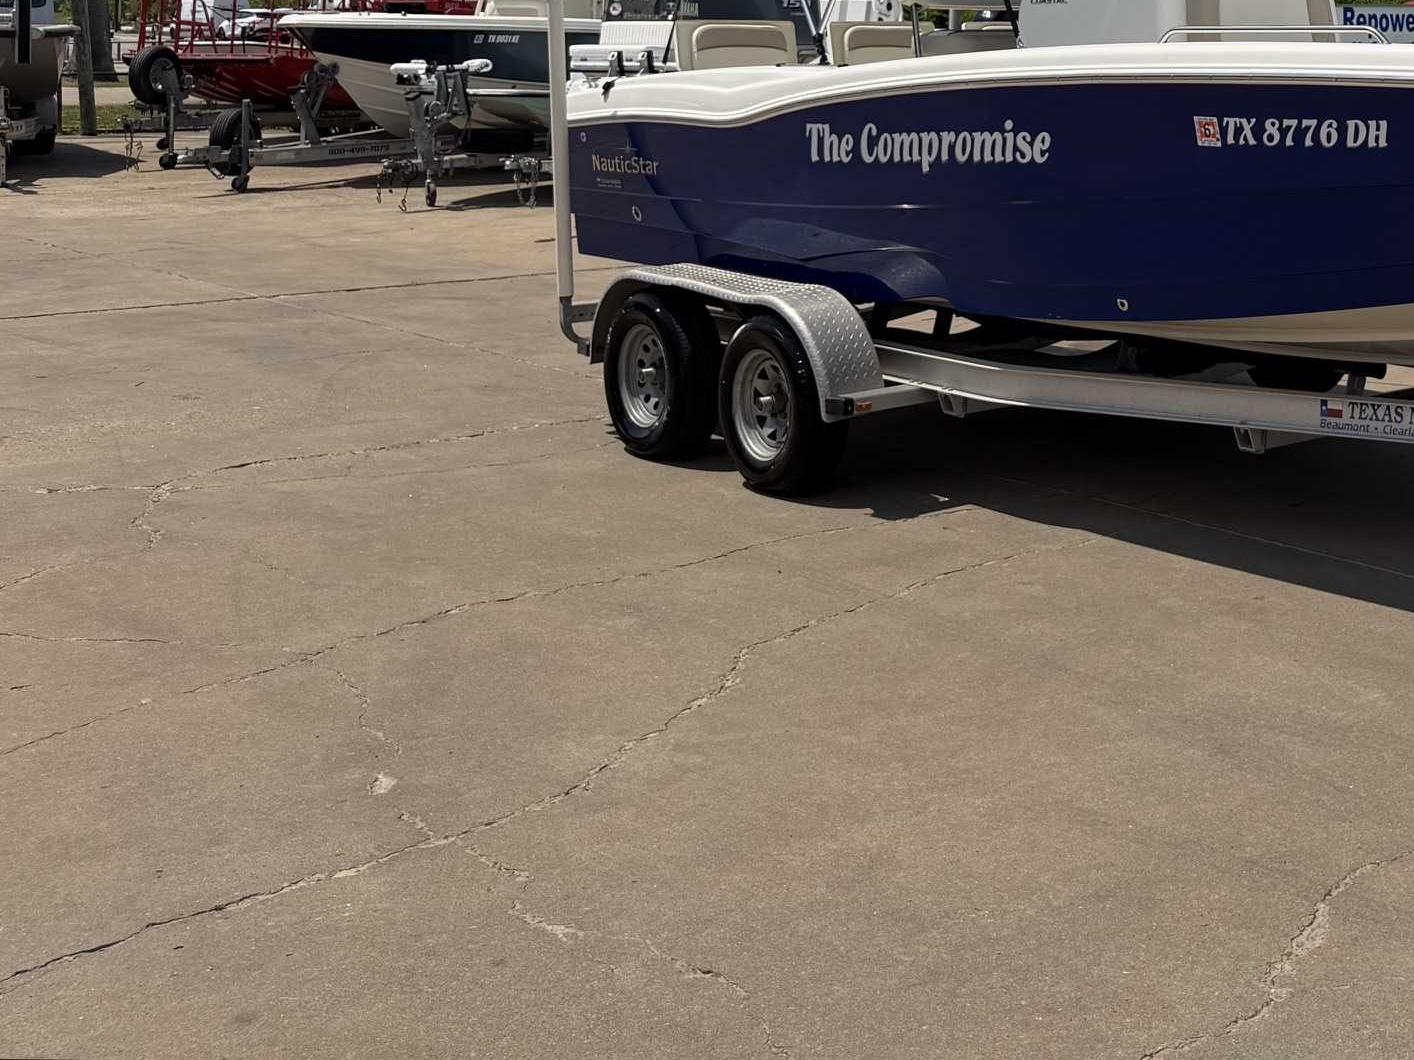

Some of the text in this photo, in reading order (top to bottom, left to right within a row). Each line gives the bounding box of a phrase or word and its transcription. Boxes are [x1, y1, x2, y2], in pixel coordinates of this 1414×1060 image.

[1223, 117, 1389, 148] TX 8776 DH
[806, 119, 1051, 174] The Compromise
[591, 153, 660, 176] NauticStar
[1348, 401, 1404, 424] TEXAS
[1320, 418, 1370, 433] Beaumont
